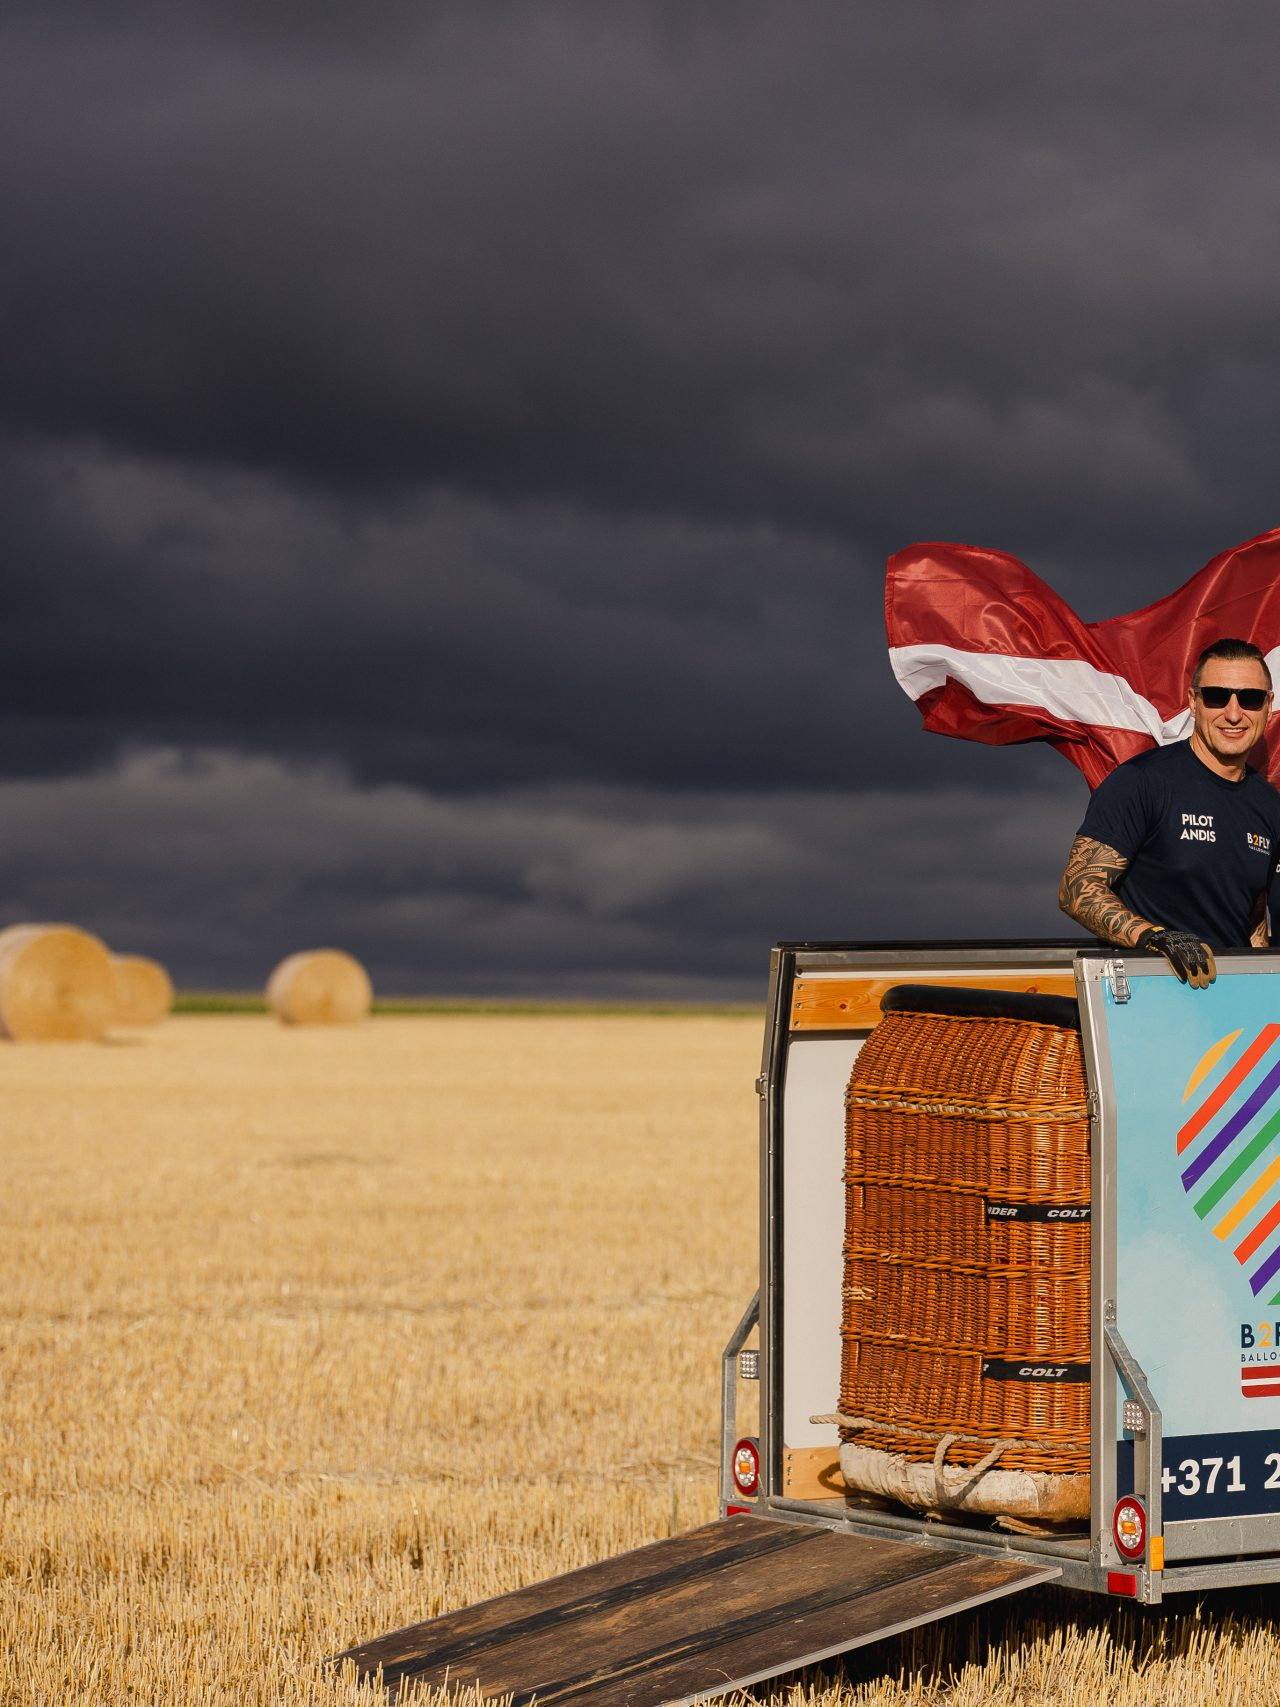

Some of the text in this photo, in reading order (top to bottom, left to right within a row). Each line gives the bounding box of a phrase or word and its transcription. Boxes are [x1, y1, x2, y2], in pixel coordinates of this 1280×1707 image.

[1181, 813, 1214, 828] PILOT
[1180, 828, 1217, 843] ANDIS
[1246, 832, 1271, 850] B2FLY
[1047, 1209, 1091, 1218] COLT
[1018, 1367, 1069, 1377] COLT
[1161, 1455, 1246, 1496] +371
